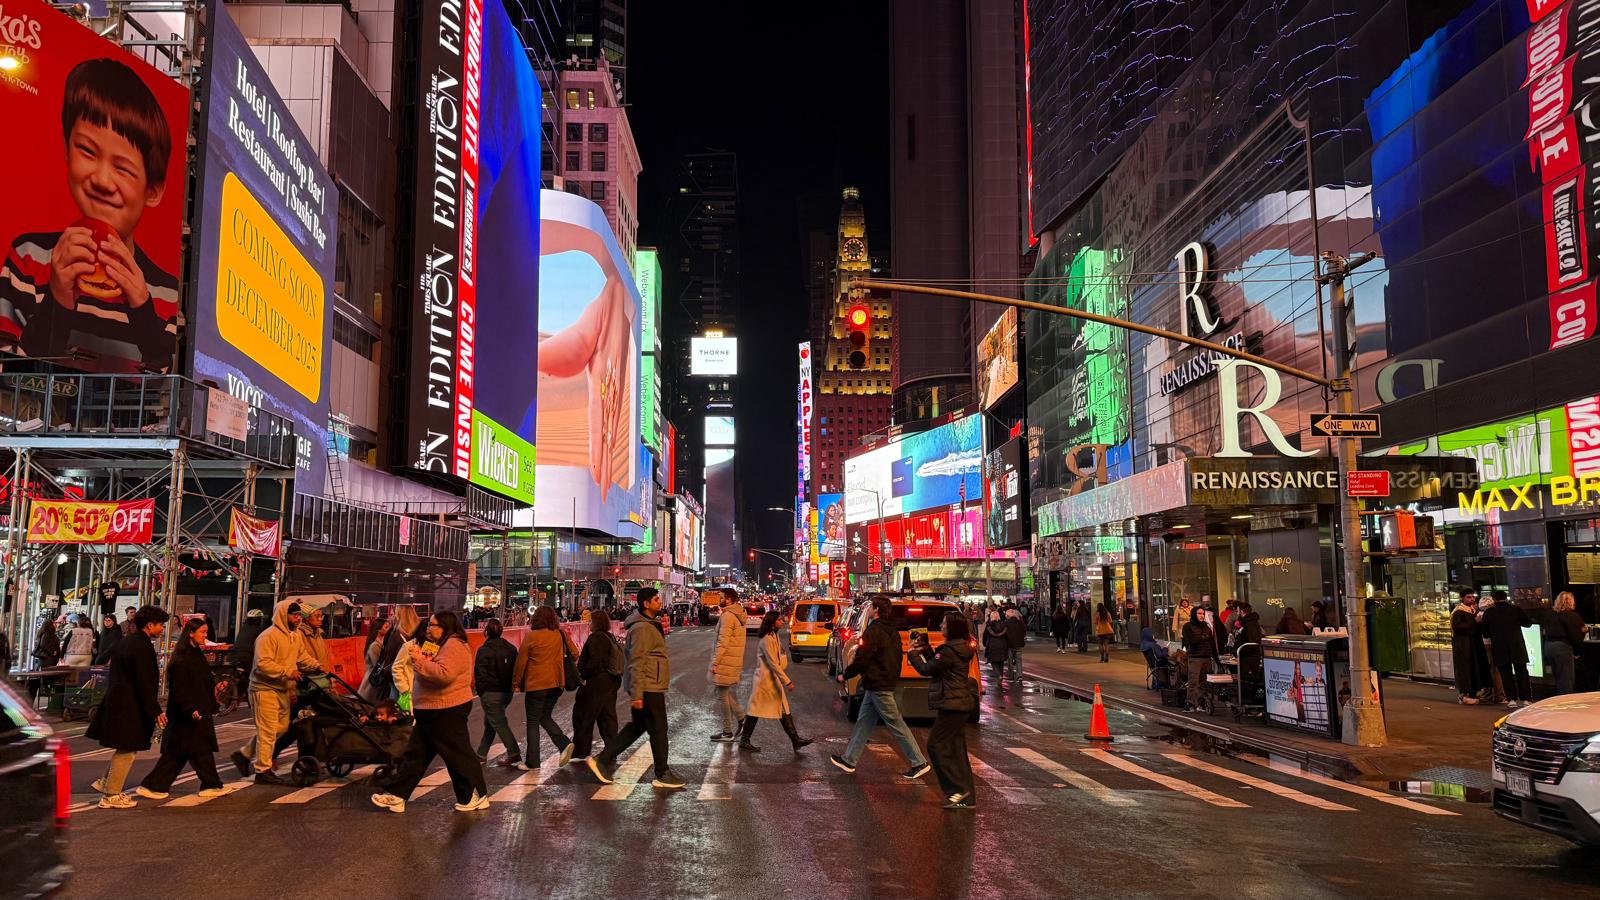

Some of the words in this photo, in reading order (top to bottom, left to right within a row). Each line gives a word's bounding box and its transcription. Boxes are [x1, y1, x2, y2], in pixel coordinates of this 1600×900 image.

[237, 57, 266, 123] Hotel
[272, 112, 307, 186] Rooftop
[307, 165, 321, 204] Bar
[433, 65, 459, 229] EDITION
[229, 97, 285, 195] Restaurant
[290, 184, 312, 231] Sushi
[313, 213, 326, 249] Bar
[233, 208, 286, 290] COMING
[289, 268, 317, 320] SOON
[1174, 241, 1224, 351] R
[226, 268, 293, 355] DECEMBER
[296, 332, 317, 374] 2025
[427, 244, 454, 409] EDITION
[459, 300, 474, 389] COME
[801, 367, 810, 377] NY
[1211, 359, 1320, 457] R
[298, 436, 312, 458] GIE
[802, 379, 811, 455] APPLES
[1324, 420, 1342, 430] ONE
[1352, 421, 1372, 430] WAY
[296, 457, 311, 471] CAFE
[1193, 471, 1338, 489] RENAISSANCE
[1458, 482, 1534, 516] MAX
[30, 506, 68, 535] 20%
[73, 507, 109, 535] 50%
[112, 508, 152, 533] OFF
[834, 563, 847, 588] tkts
